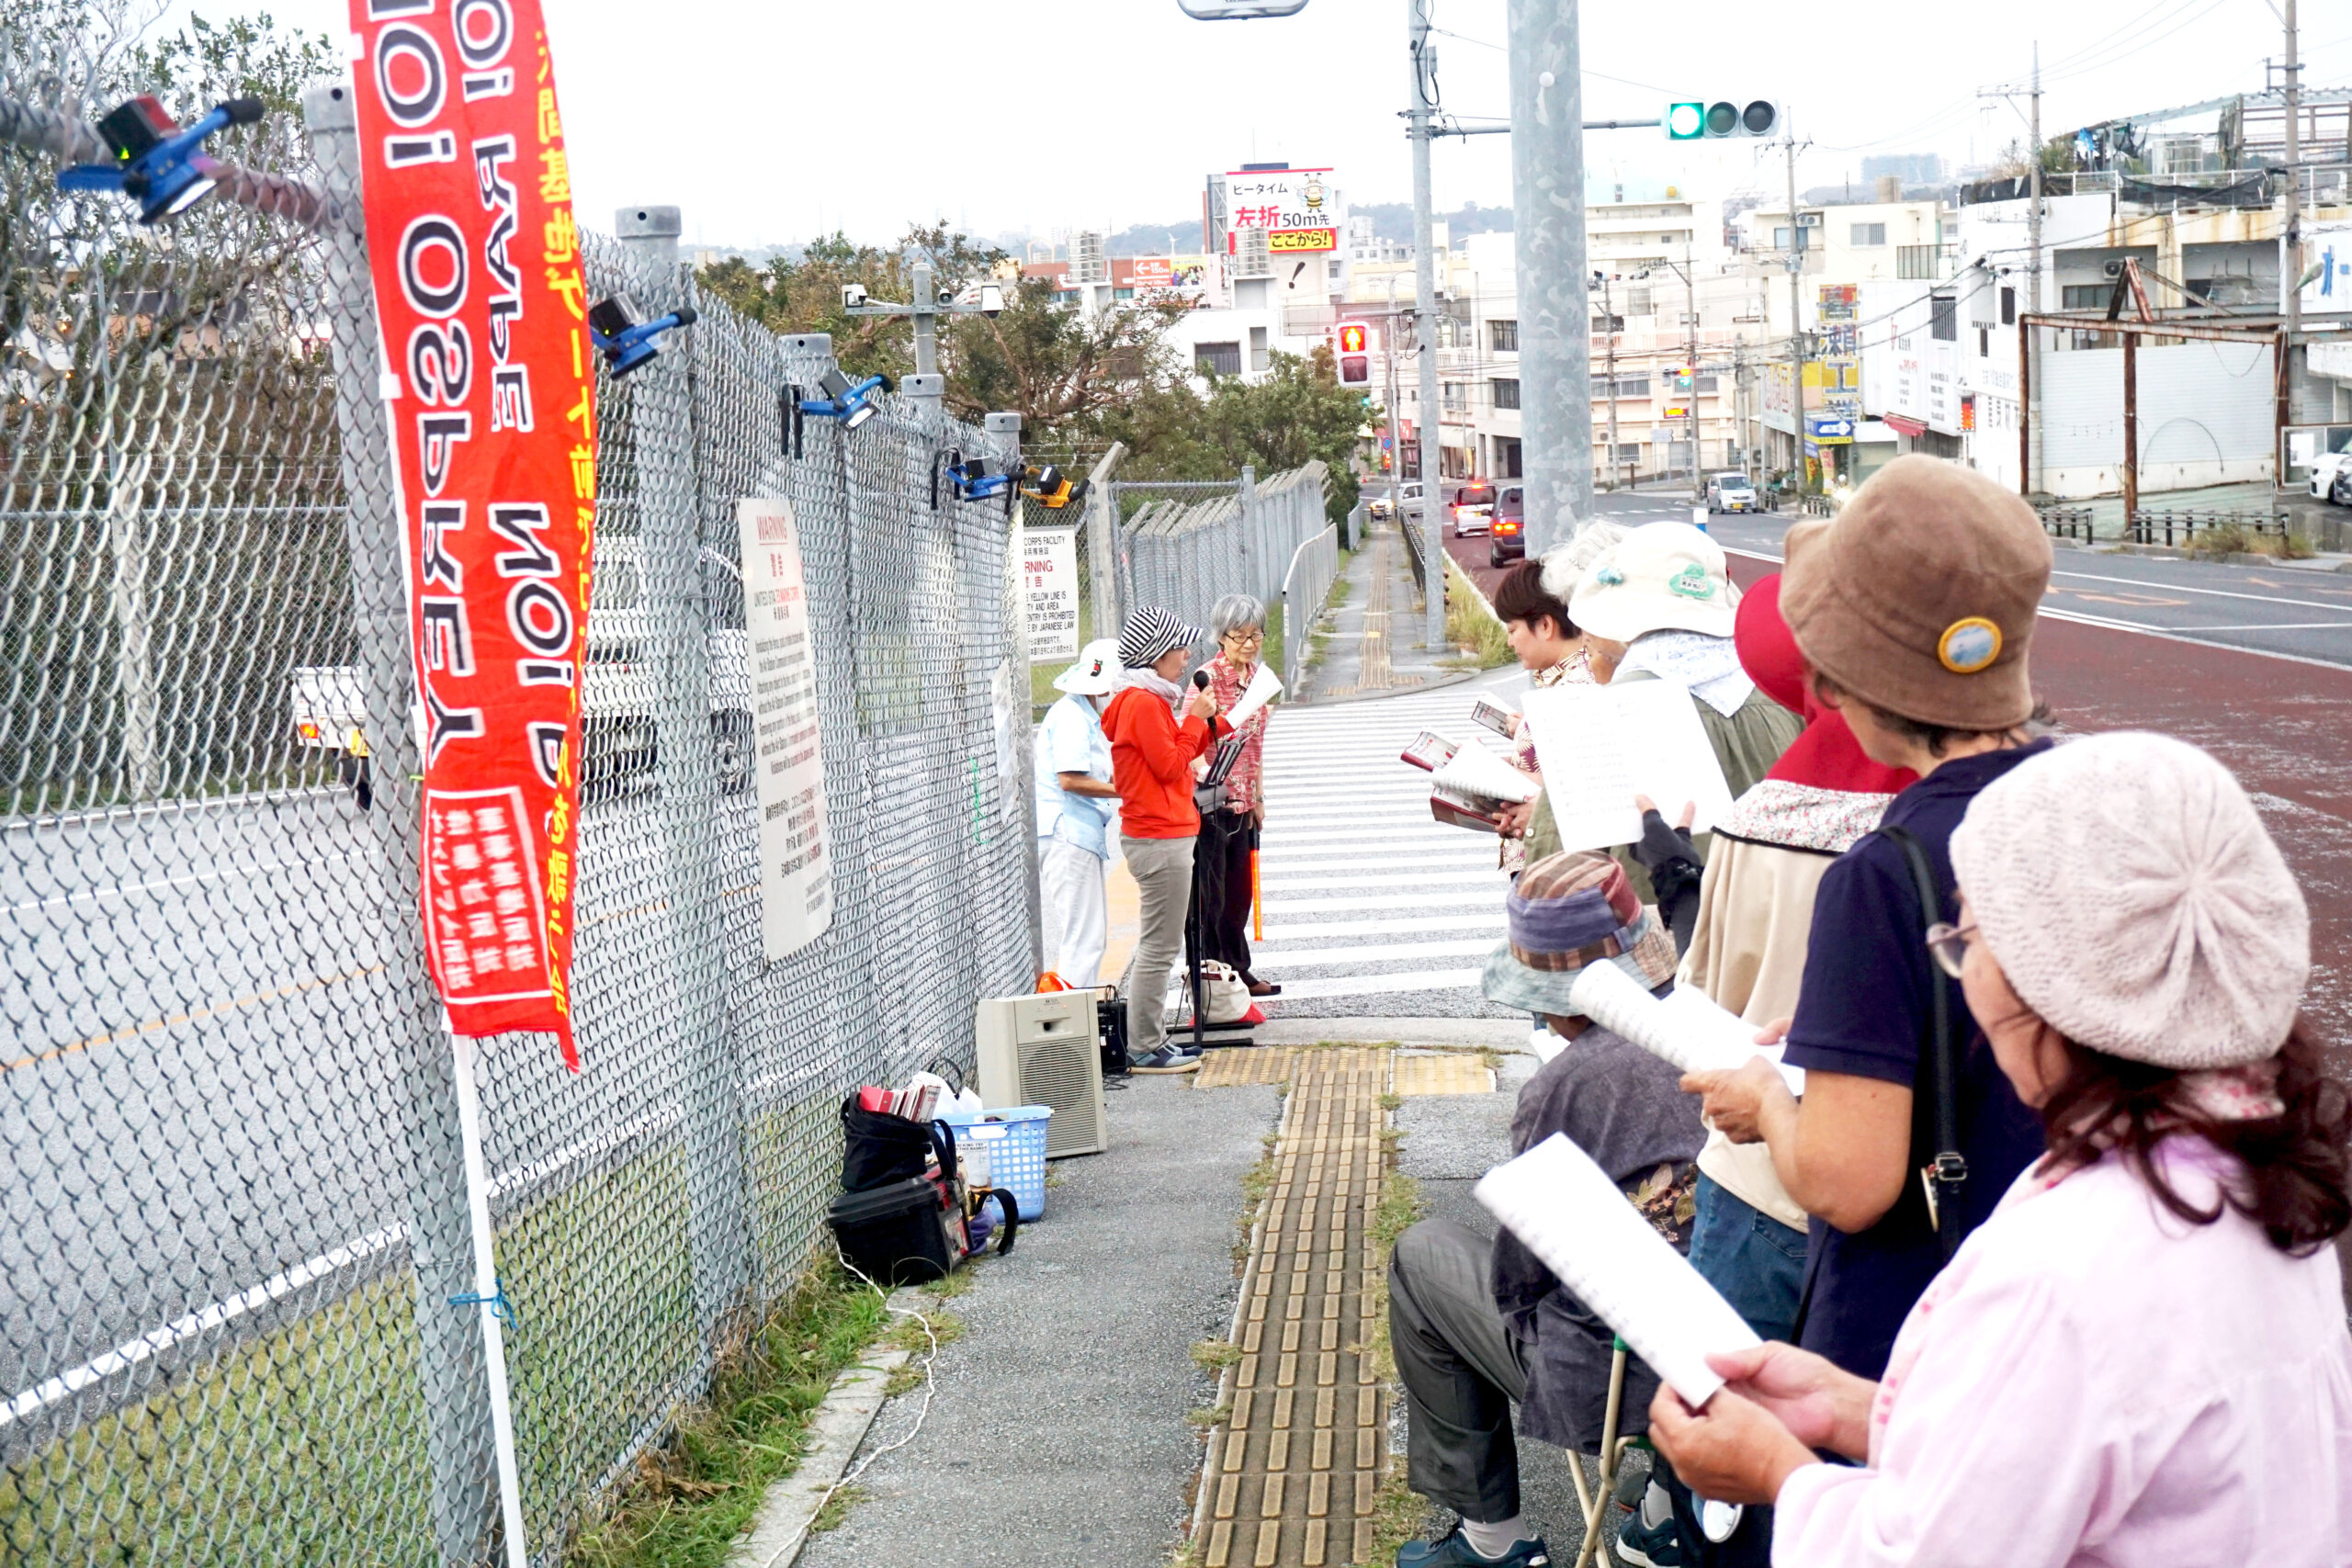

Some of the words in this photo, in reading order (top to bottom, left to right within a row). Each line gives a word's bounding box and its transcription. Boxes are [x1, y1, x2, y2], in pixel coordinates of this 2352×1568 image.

[1235, 205, 1281, 228] 左折
[756, 515, 787, 541] WARNING
[1023, 536, 1043, 547] CORPS
[1043, 536, 1066, 546] FACILITY
[1024, 559, 1054, 573] RNING
[1030, 592, 1049, 602] YELLOW
[1050, 591, 1060, 601] LINE
[1061, 591, 1067, 600] IS
[1035, 603, 1046, 612] AND
[1046, 602, 1059, 611] AREA
[1043, 612, 1047, 621] IS
[1048, 610, 1075, 621] PROHIBITED
[1032, 623, 1037, 632] BY
[1039, 621, 1063, 632] JAPANESE
[1064, 620, 1075, 630] LAW
